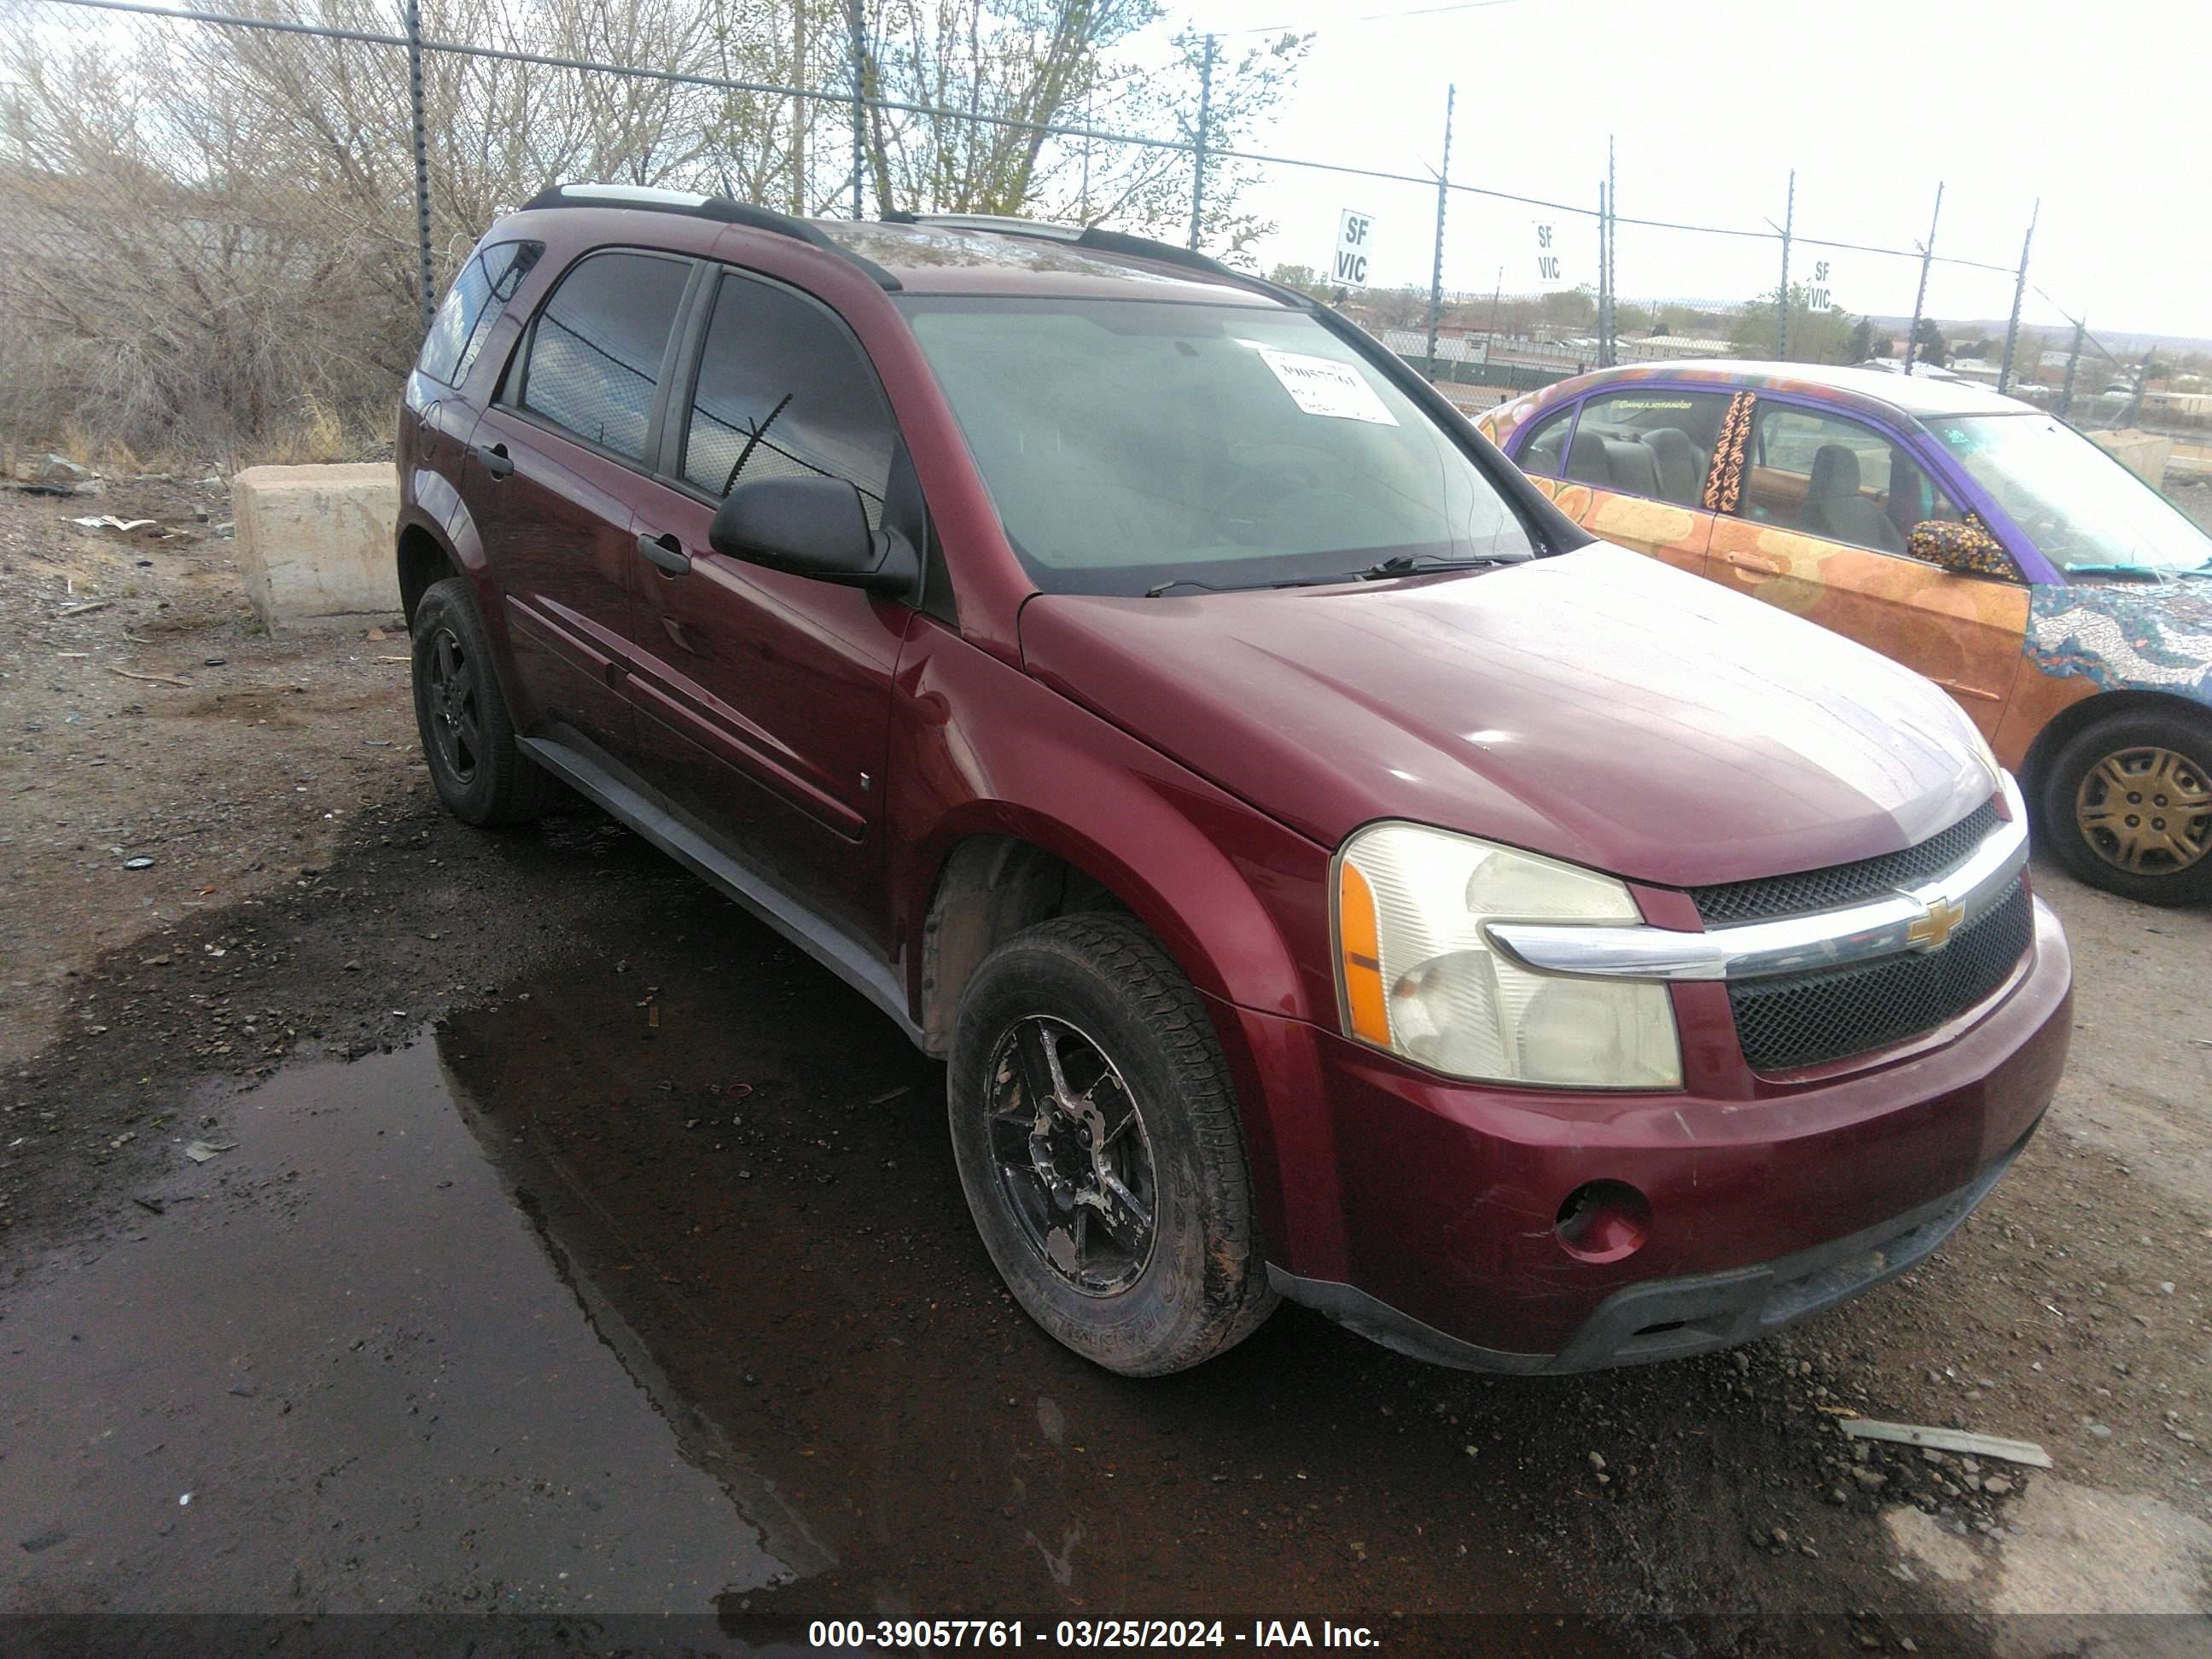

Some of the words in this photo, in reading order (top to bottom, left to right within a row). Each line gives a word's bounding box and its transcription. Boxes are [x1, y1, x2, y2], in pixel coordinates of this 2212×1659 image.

[1346, 216, 1369, 245] SF
[1538, 225, 1551, 247] SF
[1338, 251, 1367, 282] VIC
[1538, 256, 1560, 279] VIC
[1816, 261, 1830, 281] SF
[1812, 288, 1831, 309] VIC
